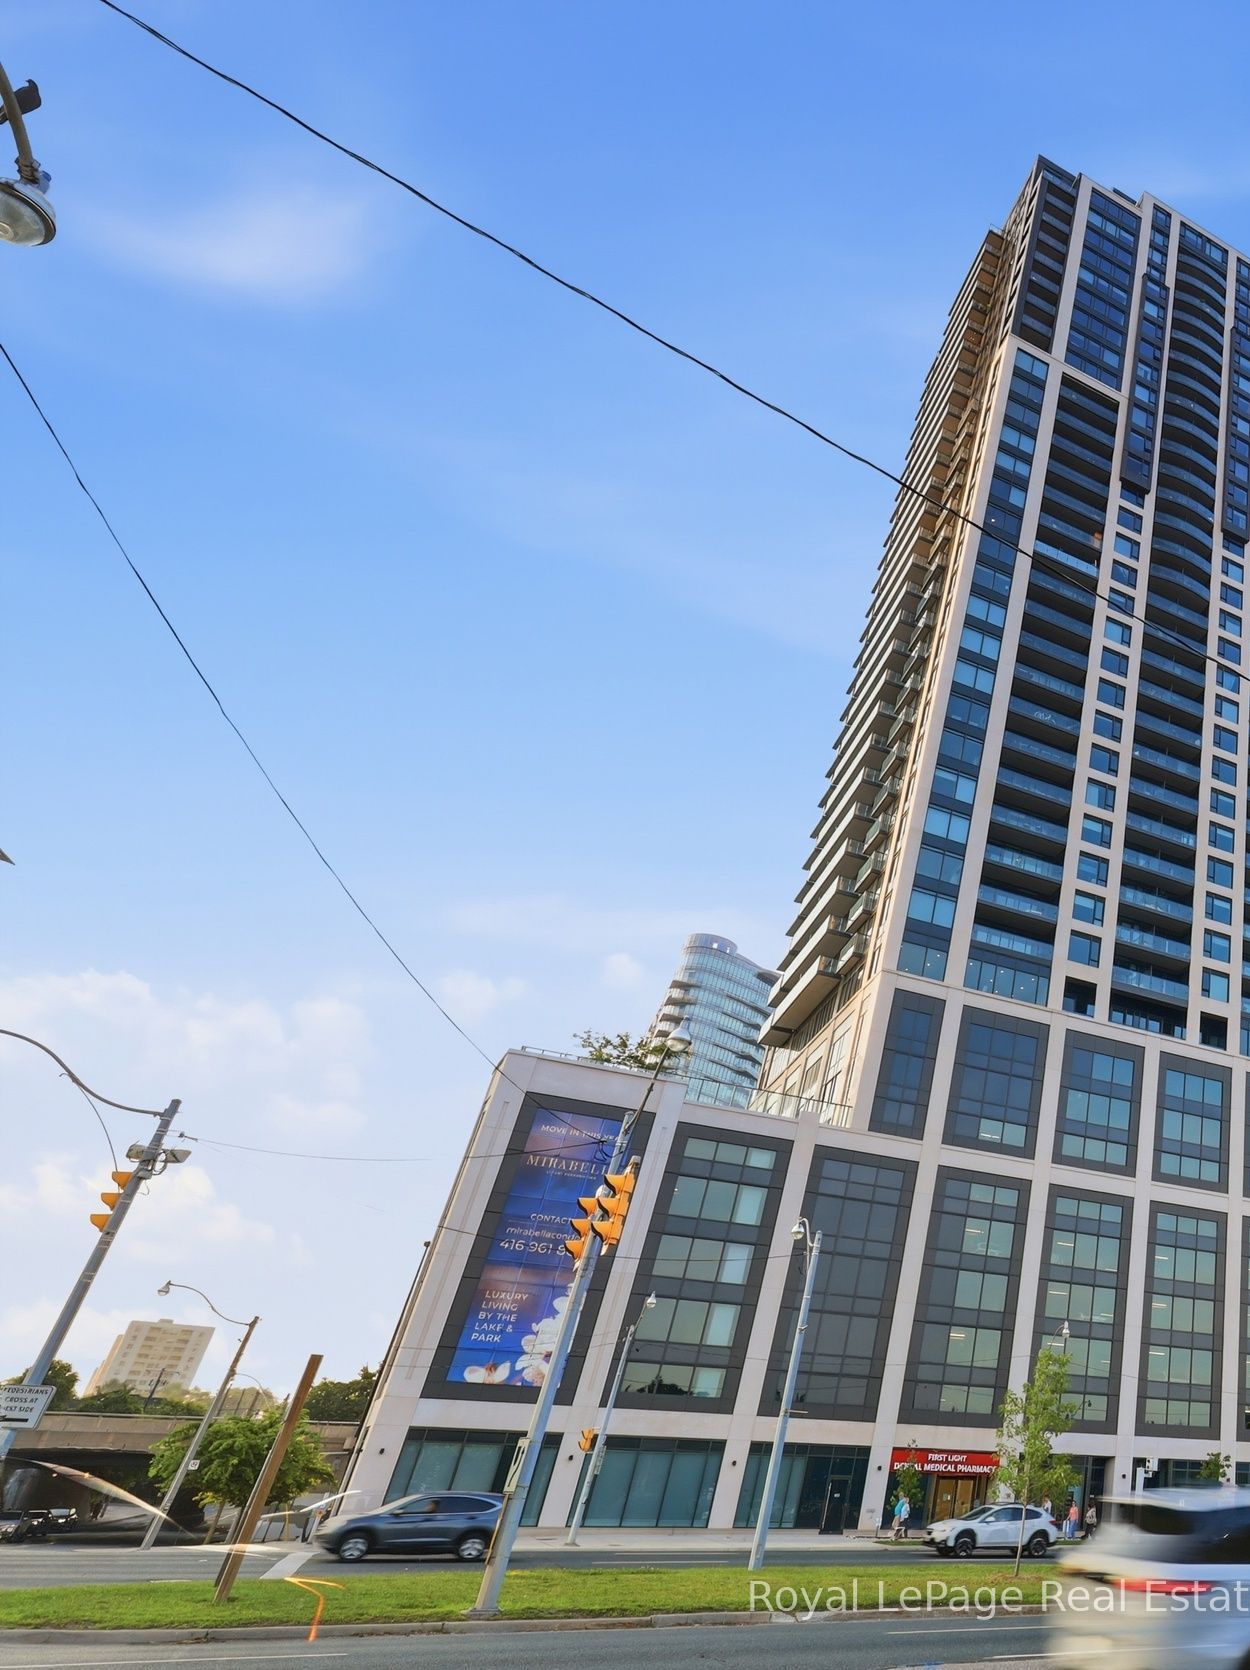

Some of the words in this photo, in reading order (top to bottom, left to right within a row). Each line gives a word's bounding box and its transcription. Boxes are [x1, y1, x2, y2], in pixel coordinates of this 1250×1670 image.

[541, 1125, 566, 1134] MOVE
[569, 1129, 580, 1137] IN
[527, 1155, 608, 1175] MIRABELL
[530, 1213, 572, 1224] CONTACT
[506, 1227, 581, 1240] mirabellacondo
[500, 1239, 526, 1250] 416
[528, 1242, 552, 1254] 961
[485, 1290, 528, 1300] LUXURY
[482, 1301, 518, 1311] LIVING
[478, 1311, 493, 1320] BY
[496, 1313, 518, 1322] THE
[474, 1322, 504, 1331] LAKE
[506, 1324, 513, 1332] &
[471, 1333, 501, 1342] PARK
[5, 1396, 28, 1404] CROSS
[928, 1453, 948, 1461] FIRST
[948, 1454, 968, 1462] LIGHT
[924, 1463, 956, 1472] MEDICAL
[957, 1464, 997, 1473] PHARMACY
